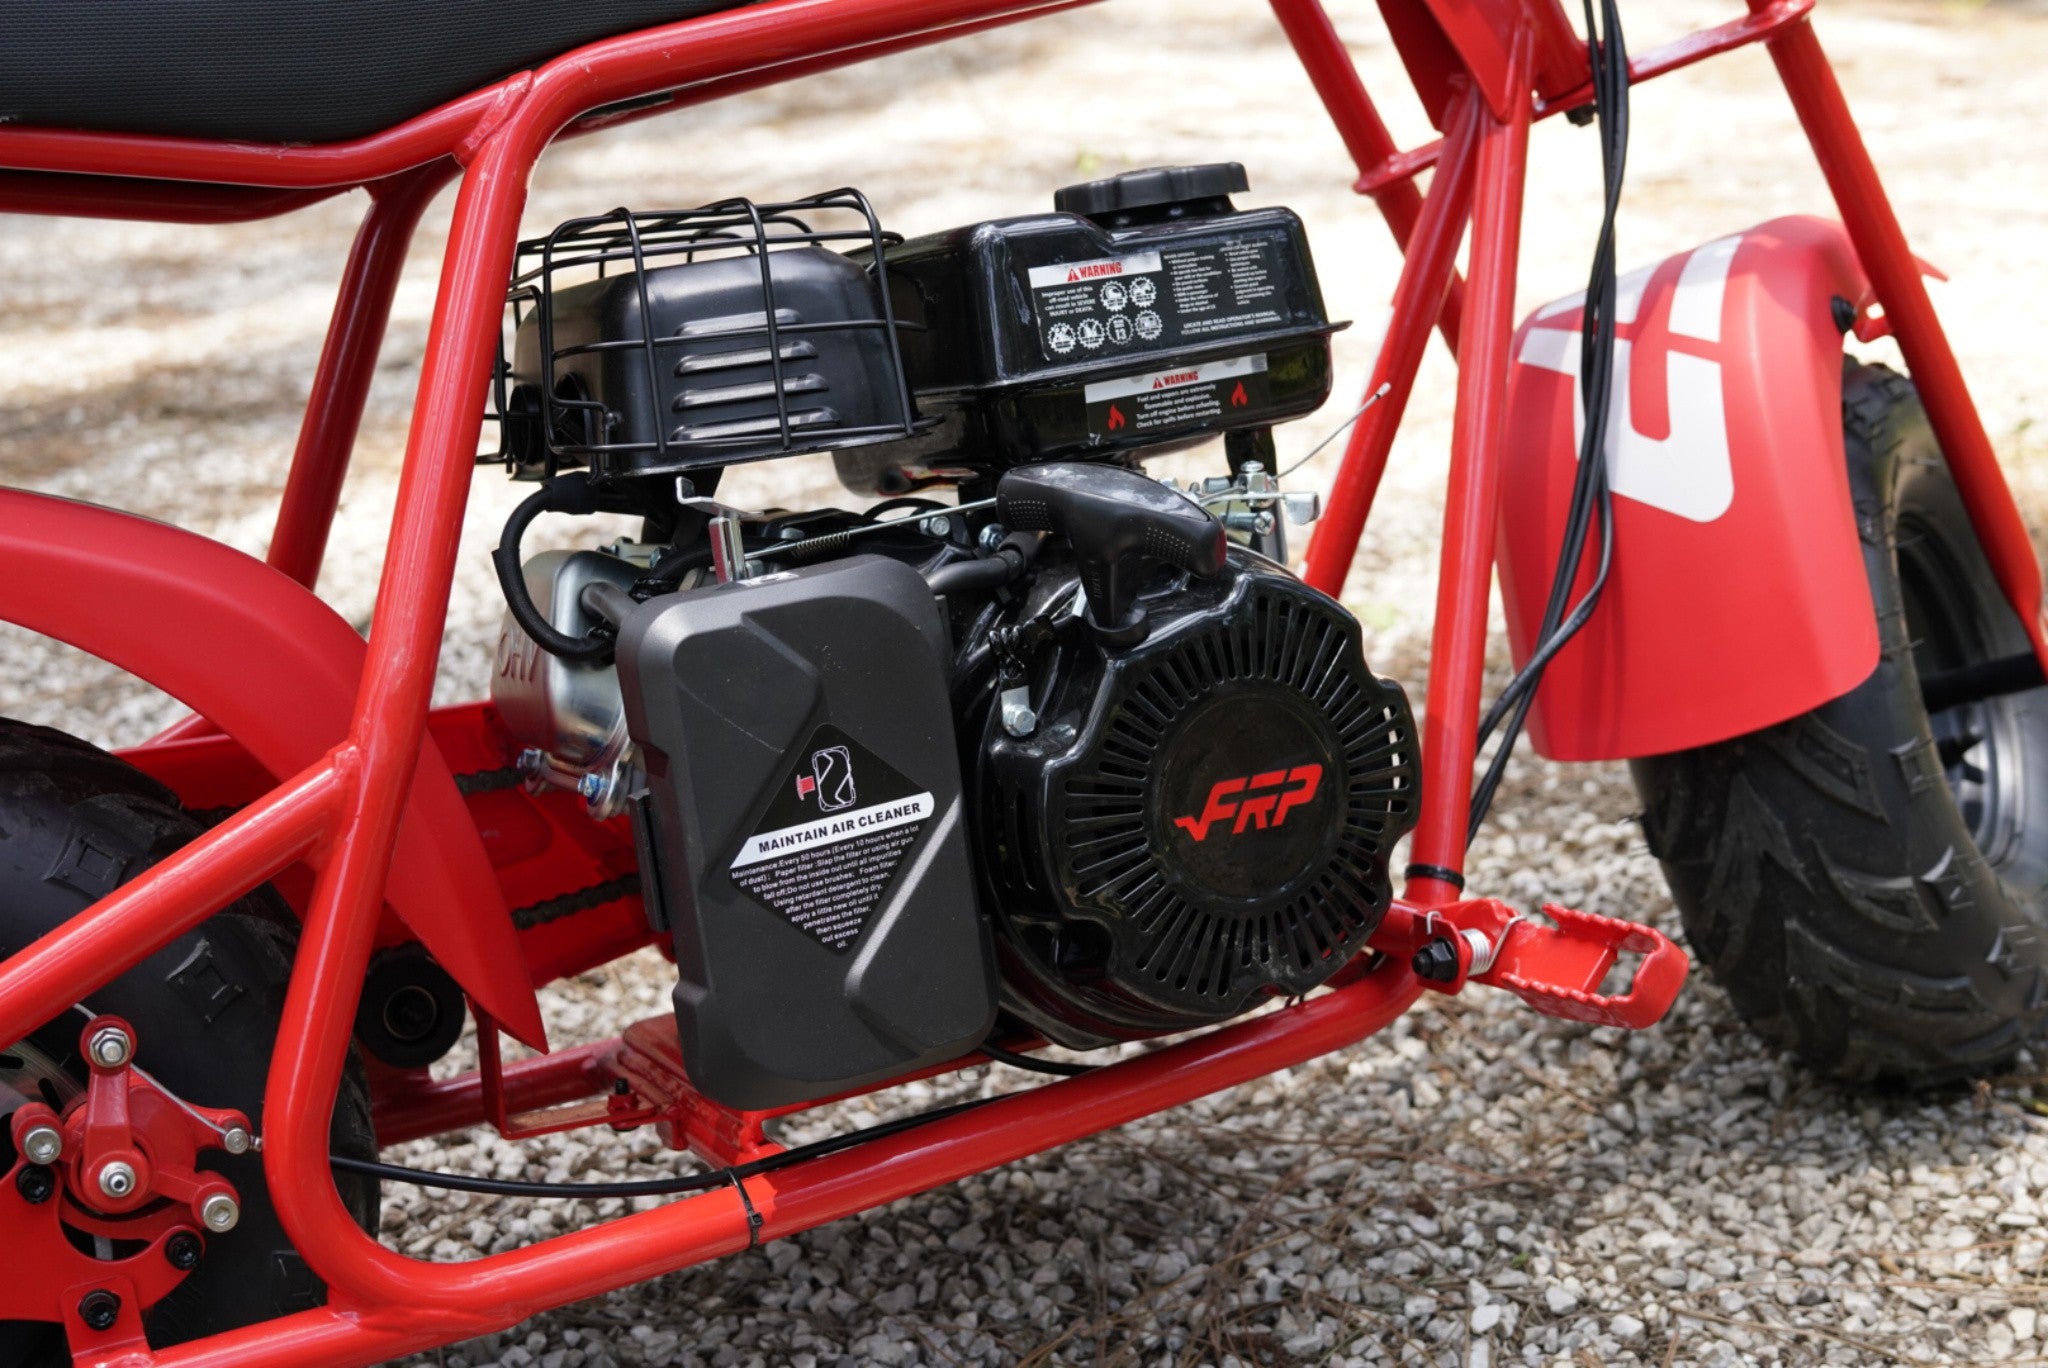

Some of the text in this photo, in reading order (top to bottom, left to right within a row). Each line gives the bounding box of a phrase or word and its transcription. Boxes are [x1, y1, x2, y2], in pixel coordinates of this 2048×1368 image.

[1080, 262, 1122, 277] WARNING
[1164, 371, 1198, 385] WARNING
[1173, 763, 1323, 842] FRP
[759, 803, 920, 852] MAINTAIN AIR CLEANER
[801, 853, 810, 861] 50
[811, 849, 831, 858] hours
[856, 839, 864, 847] 10
[865, 835, 885, 844] hours
[885, 830, 904, 839] when
[740, 879, 747, 887] of
[775, 868, 796, 877] Paper
[797, 863, 813, 871] filter
[871, 843, 890, 852] using
[901, 837, 913, 846] gun
[761, 882, 778, 891] blow
[779, 878, 795, 886] from
[809, 869, 830, 878] inside
[831, 865, 842, 873] out
[843, 860, 858, 869] until
[869, 850, 901, 862] impurities
[798, 883, 810, 891] not
[859, 865, 879, 874] Foam
[774, 898, 794, 907] Using
[828, 879, 861, 892] detergent
[786, 905, 801, 914] after
[815, 897, 831, 905] filter
[832, 887, 869, 901] completely
[791, 913, 810, 922] apply
[817, 907, 832, 915] little
[848, 899, 857, 907] oil
[858, 894, 873, 904] until
[803, 914, 840, 929] penetrates
[816, 918, 862, 934] then squeeze
[822, 929, 858, 943] out excess
